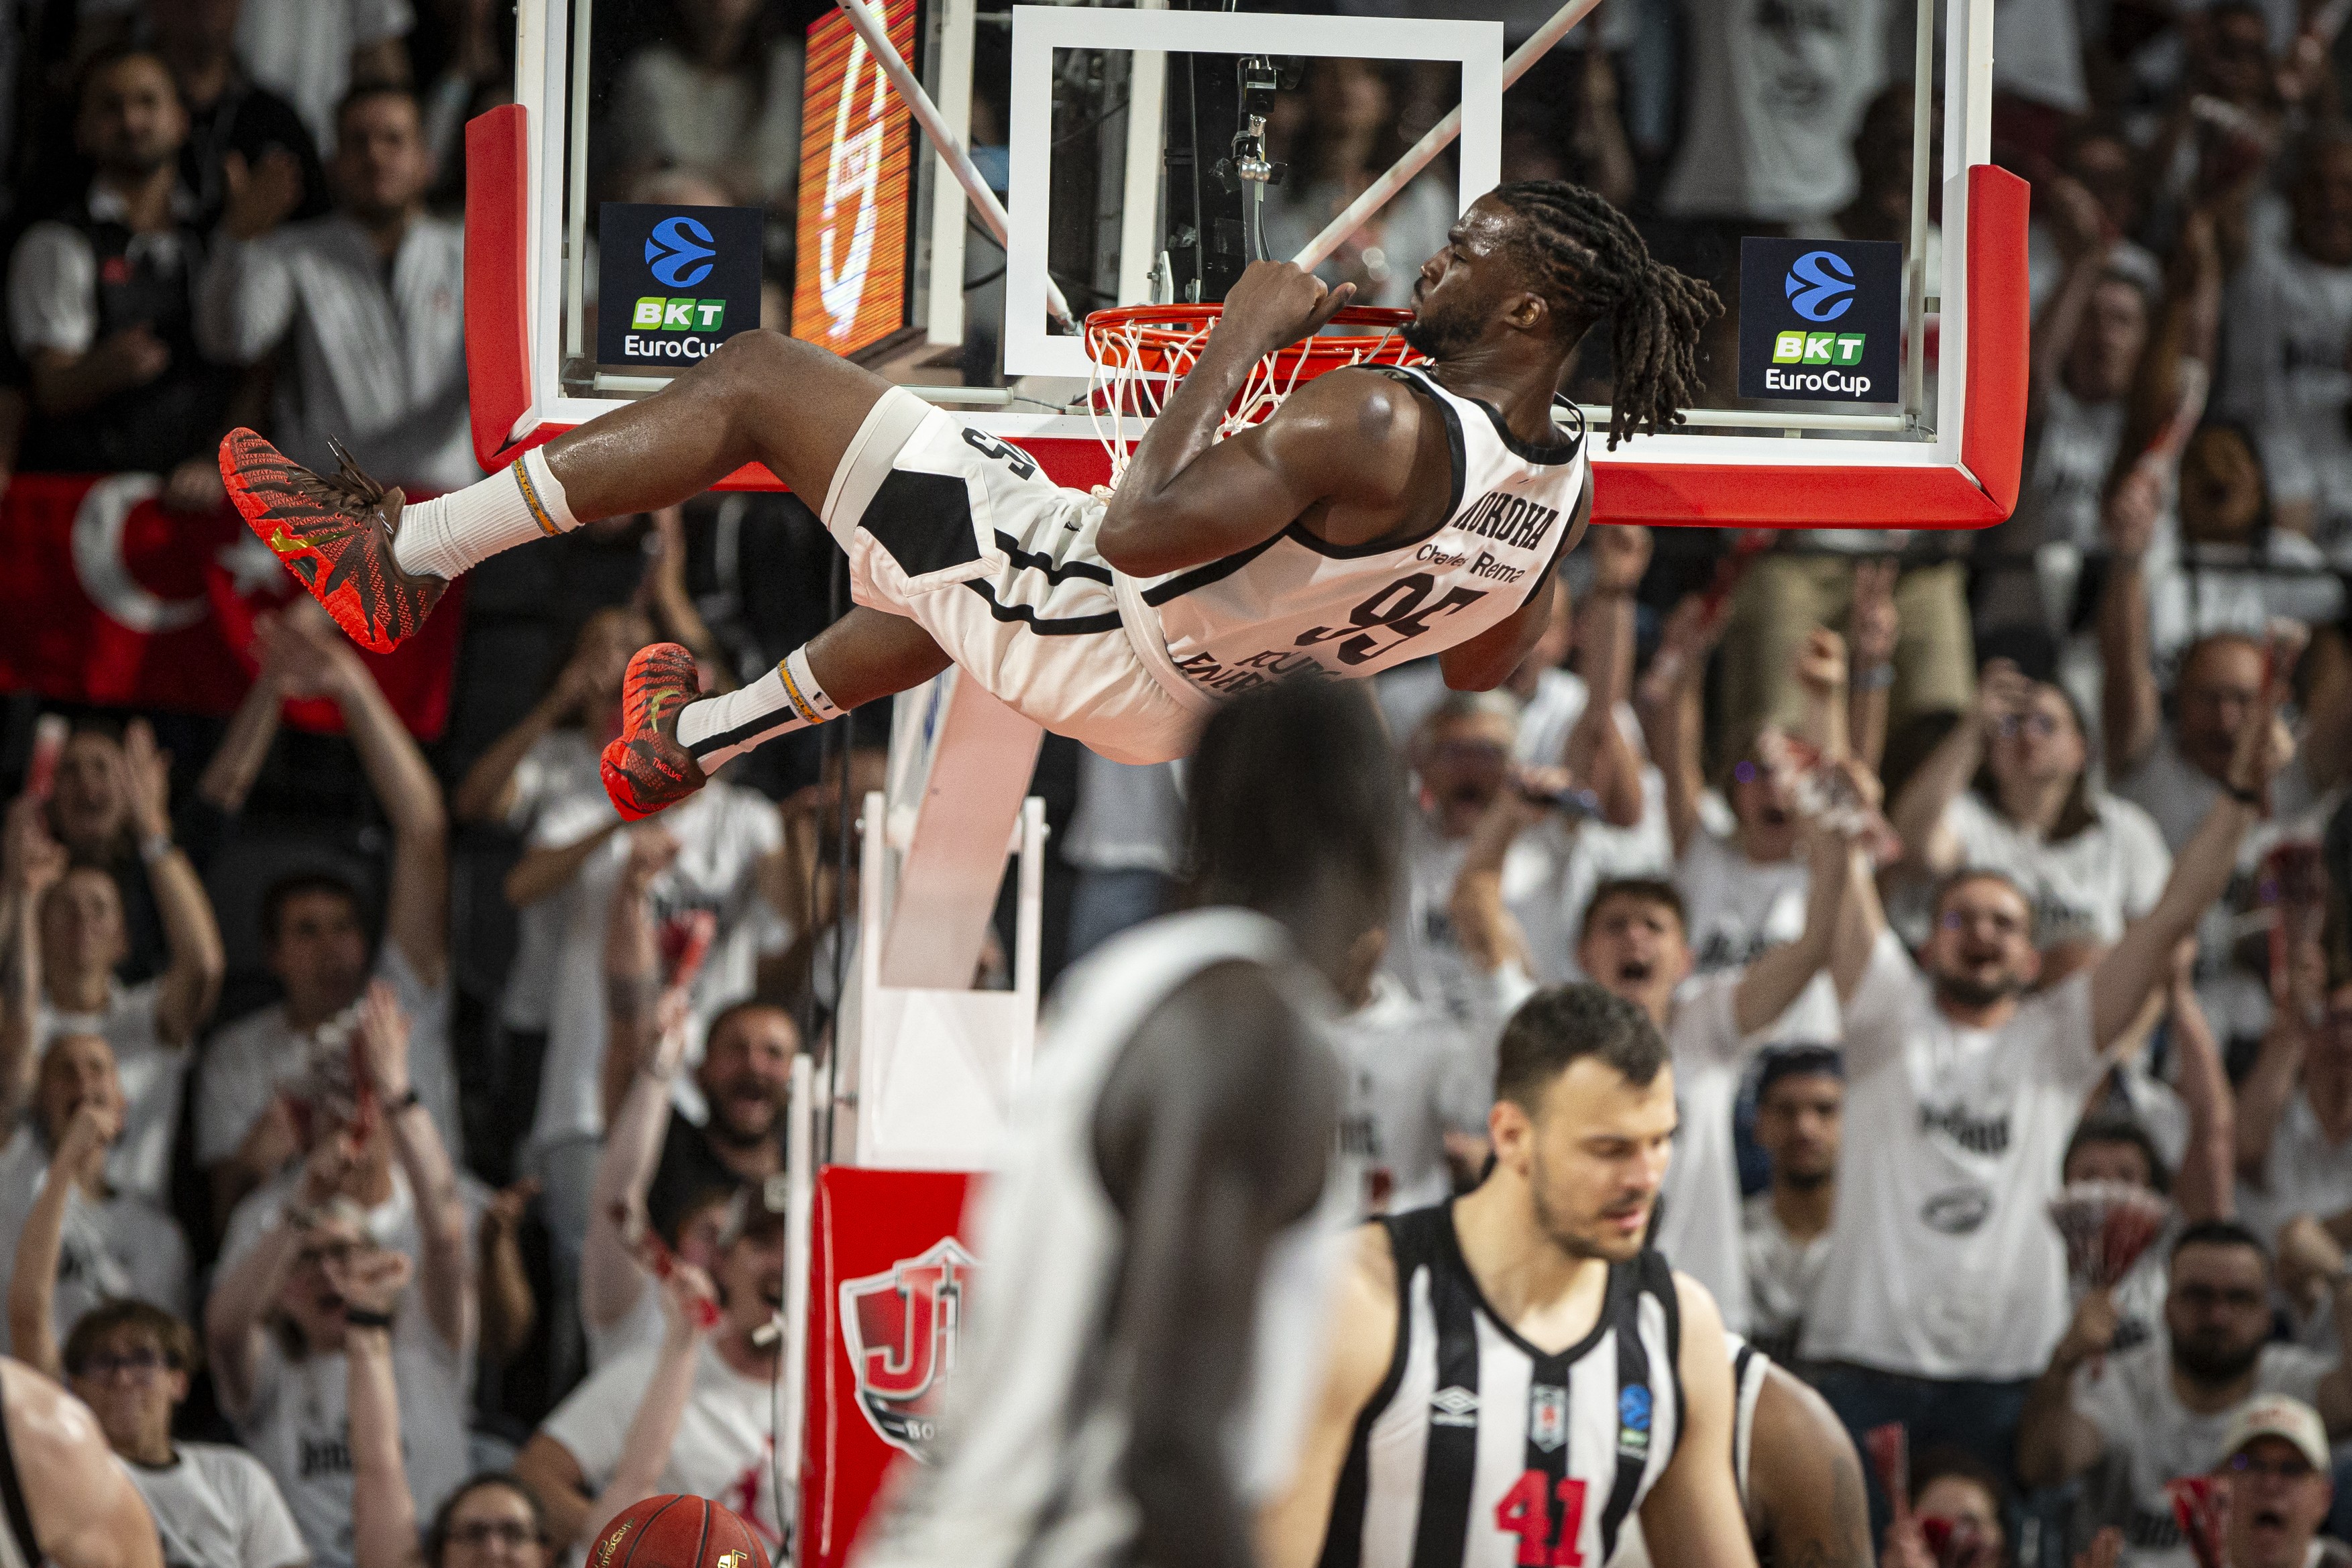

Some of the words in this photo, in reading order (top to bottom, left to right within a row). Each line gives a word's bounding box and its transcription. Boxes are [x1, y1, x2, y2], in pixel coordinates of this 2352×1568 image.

[635, 303, 722, 325] BKT
[1776, 337, 1862, 359] BKT
[1766, 369, 1871, 397] EuroCup
[1416, 544, 1469, 566] Charles
[1294, 572, 1489, 665] 95
[652, 757, 683, 783] TWELVE
[1494, 1469, 1587, 1567] 41
